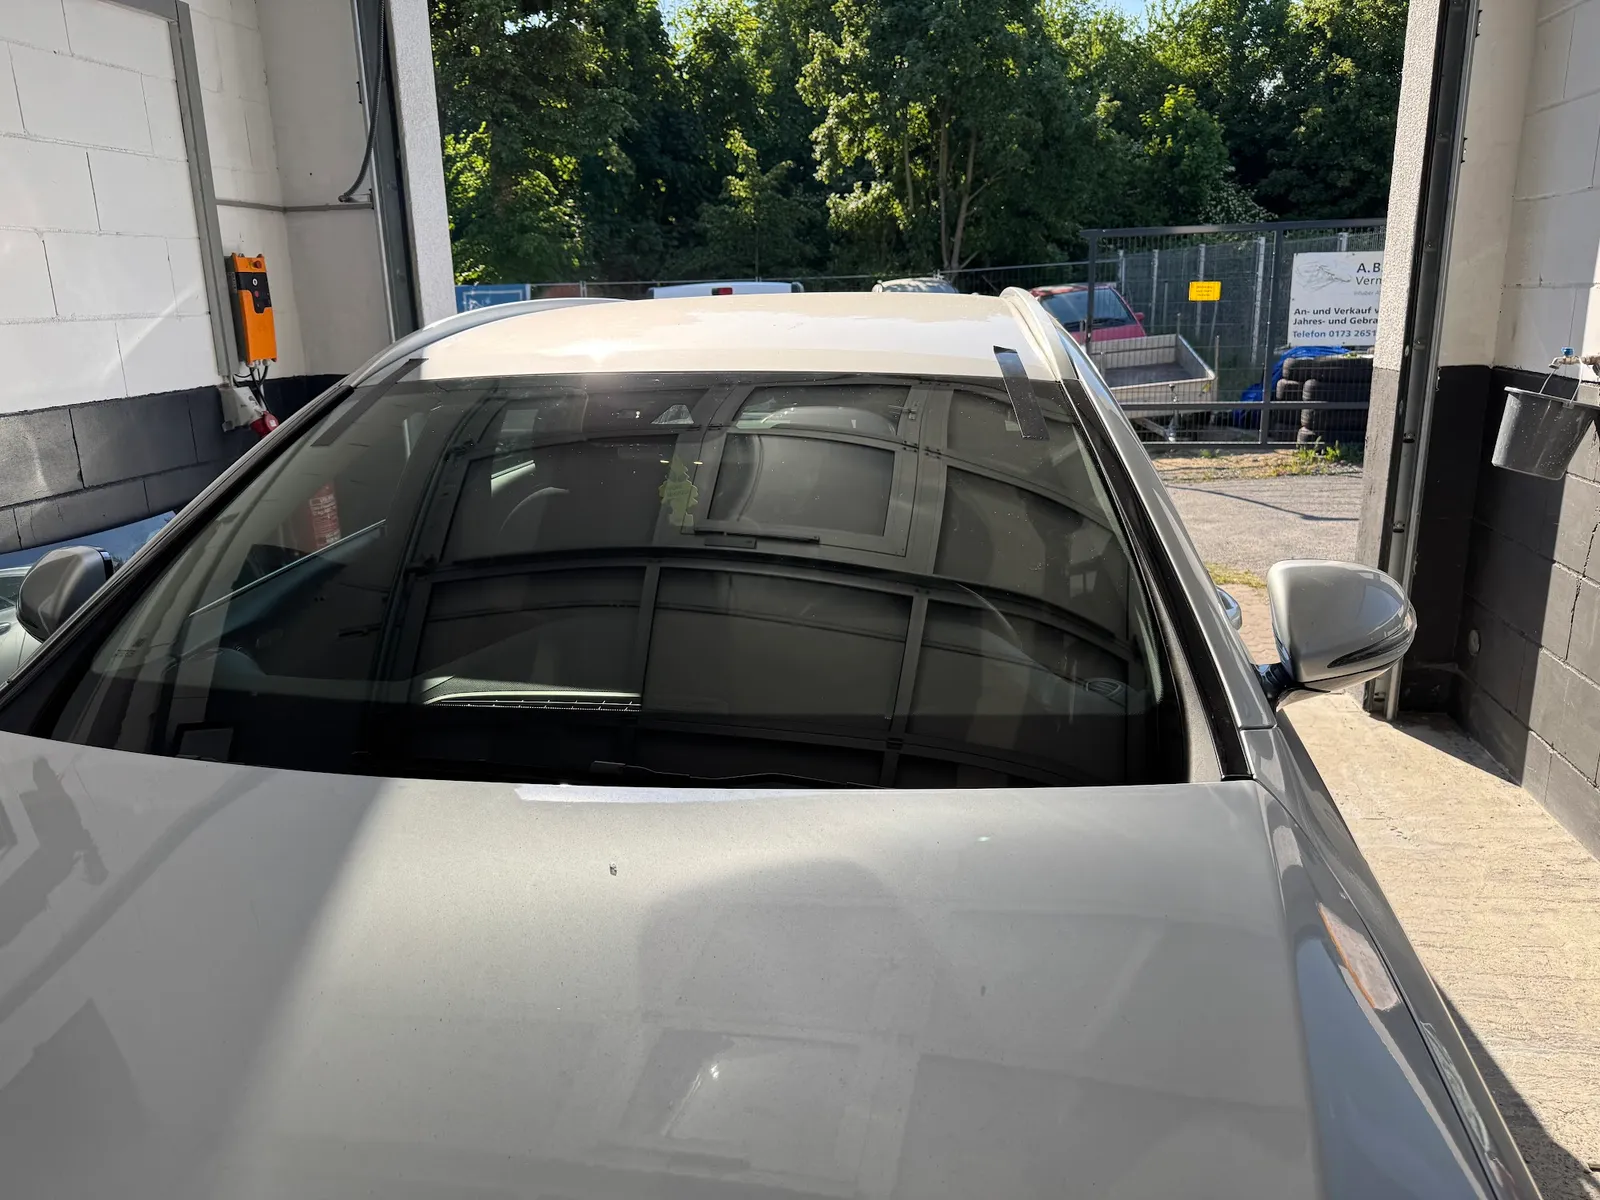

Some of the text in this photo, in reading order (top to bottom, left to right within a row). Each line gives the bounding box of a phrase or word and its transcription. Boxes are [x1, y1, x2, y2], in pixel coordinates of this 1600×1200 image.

[1312, 307, 1331, 315] und
[1334, 306, 1372, 315] Verkauf
[1293, 317, 1326, 325] Jahres-
[1328, 317, 1347, 325] und
[1292, 330, 1326, 338] Telefon
